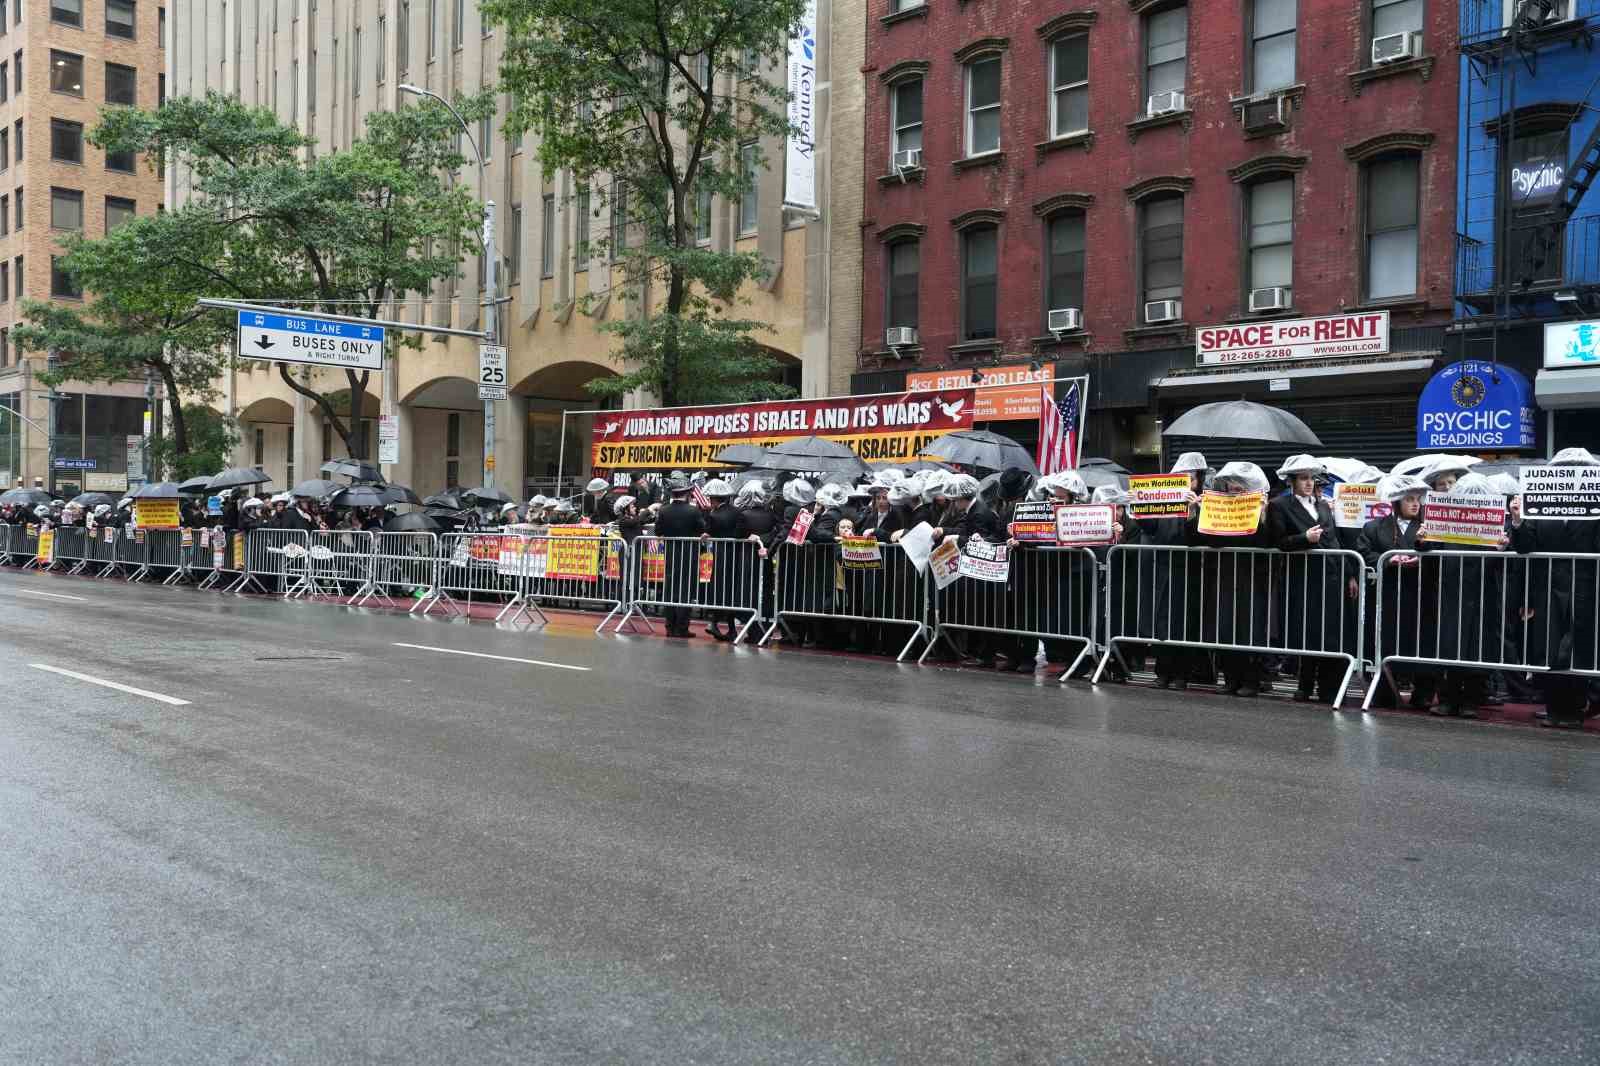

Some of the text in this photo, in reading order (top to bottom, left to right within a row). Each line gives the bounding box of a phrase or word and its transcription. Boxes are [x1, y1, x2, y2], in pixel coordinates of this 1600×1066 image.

[795, 64, 816, 160] Kennedy
[1511, 162, 1563, 195] Psychic
[286, 319, 342, 335] BUS LANE
[1201, 316, 1382, 350] SPACE FOR RENT
[292, 335, 374, 355] BUSES ONLY
[315, 352, 336, 361] RIGHT
[337, 354, 360, 362] TURNS
[1219, 348, 1293, 362] 212-265-2280
[482, 366, 504, 383] 25
[1008, 369, 1051, 383] LEASE
[623, 401, 932, 437] JUDAISM OPPOSES ISRAEL AND ITS WARS
[1423, 410, 1512, 432] PSYCHIC
[1430, 432, 1503, 446] READINGS
[600, 444, 626, 464] STOP
[627, 444, 672, 464] FORCING
[857, 437, 909, 460] ISRAELI
[1525, 469, 1576, 478] JUDAISM
[1151, 479, 1187, 488] Worldwide
[1526, 482, 1575, 491] ZIONISM
[1137, 490, 1182, 501] Condemn
[1526, 494, 1600, 503] DIAMETRICALLY
[1448, 509, 1461, 519] NOT
[1466, 510, 1486, 521] Jewish
[1486, 511, 1502, 522] State
[1542, 506, 1587, 515] OPPOSED
